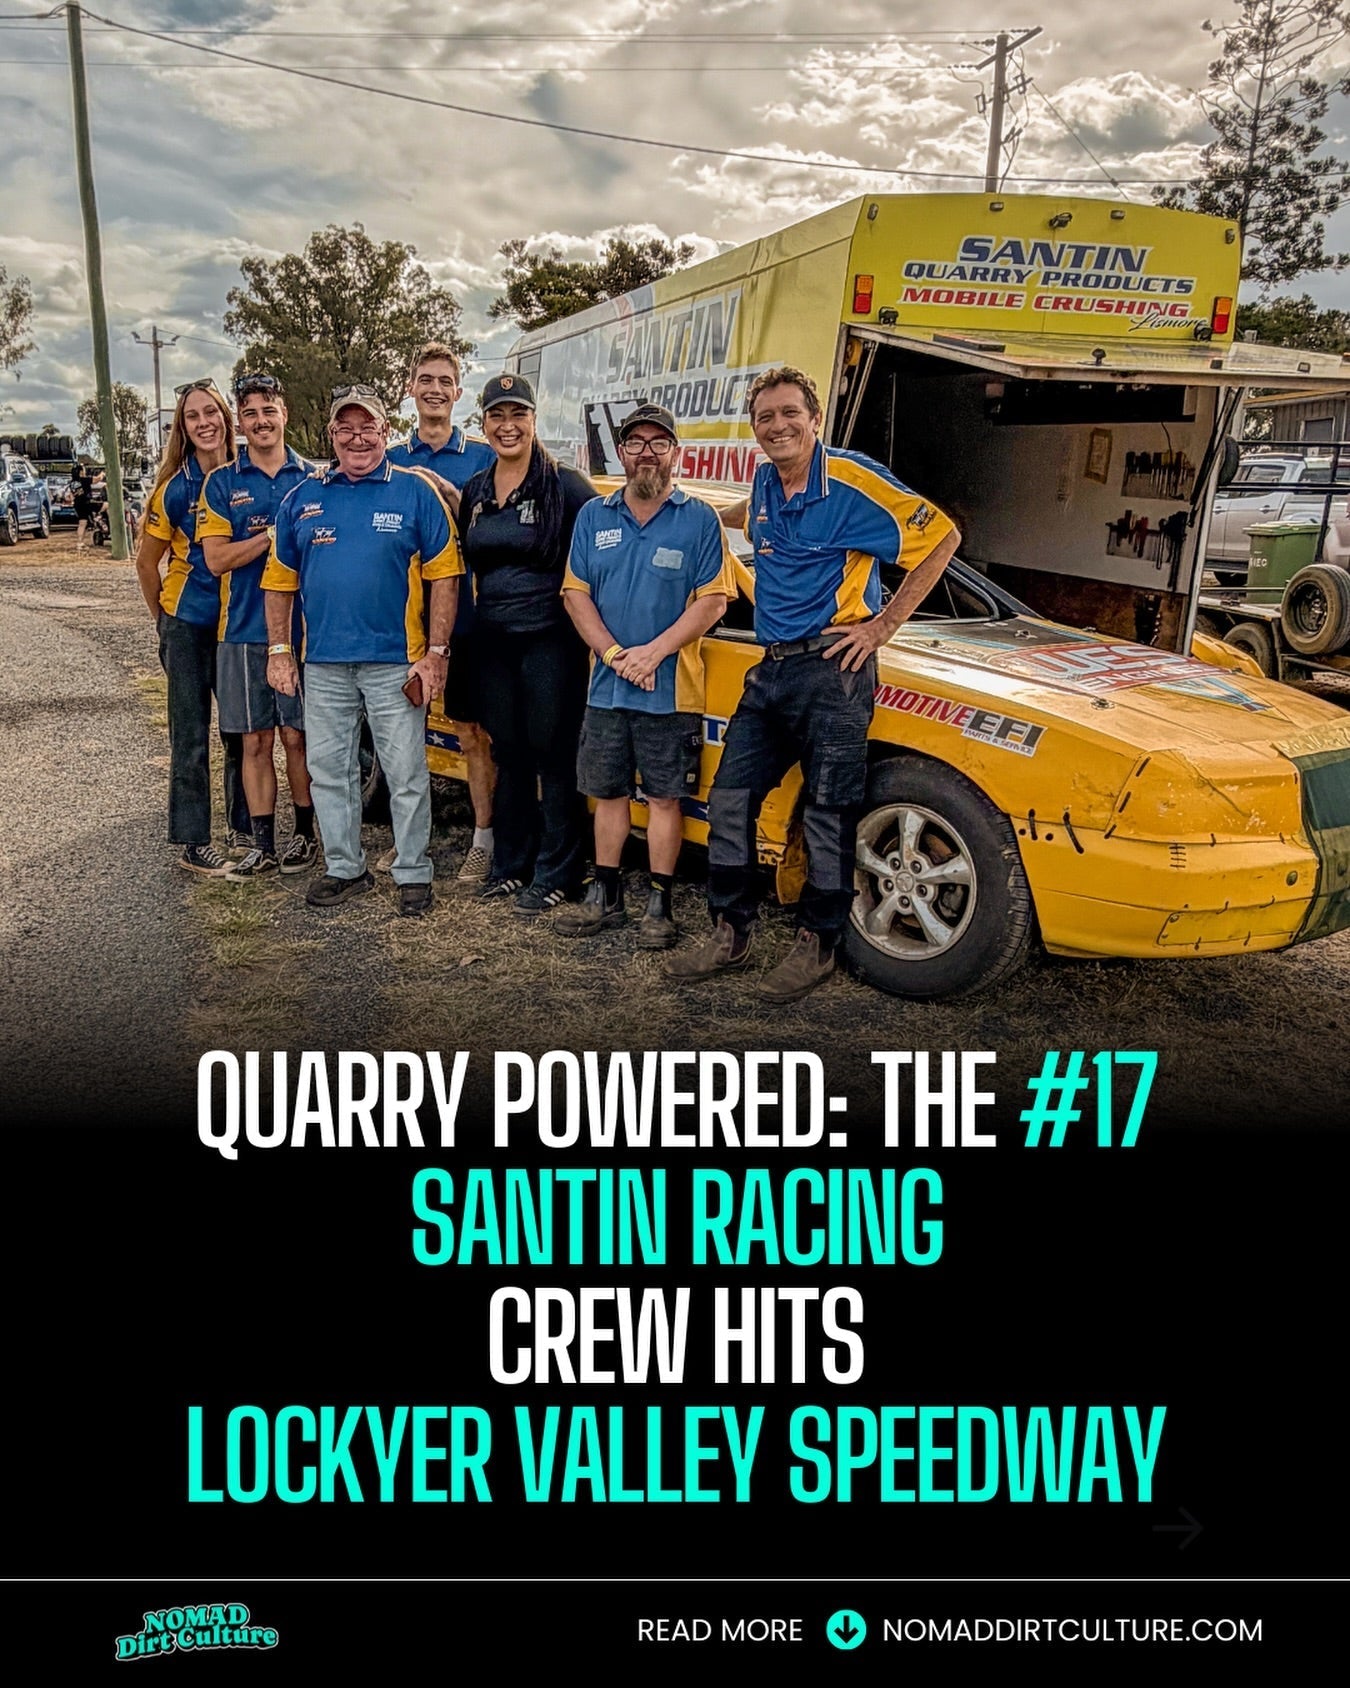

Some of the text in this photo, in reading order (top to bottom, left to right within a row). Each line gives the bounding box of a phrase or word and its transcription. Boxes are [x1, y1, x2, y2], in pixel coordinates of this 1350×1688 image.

[958, 237, 1148, 272] SANTIN
[904, 262, 1194, 294] QUARRY PRODUCTS
[902, 287, 1189, 317] MOBILE CRUSHING
[606, 295, 738, 385] SANTIN
[672, 445, 765, 483] SHING
[874, 684, 1044, 748] MOTIVE EFI
